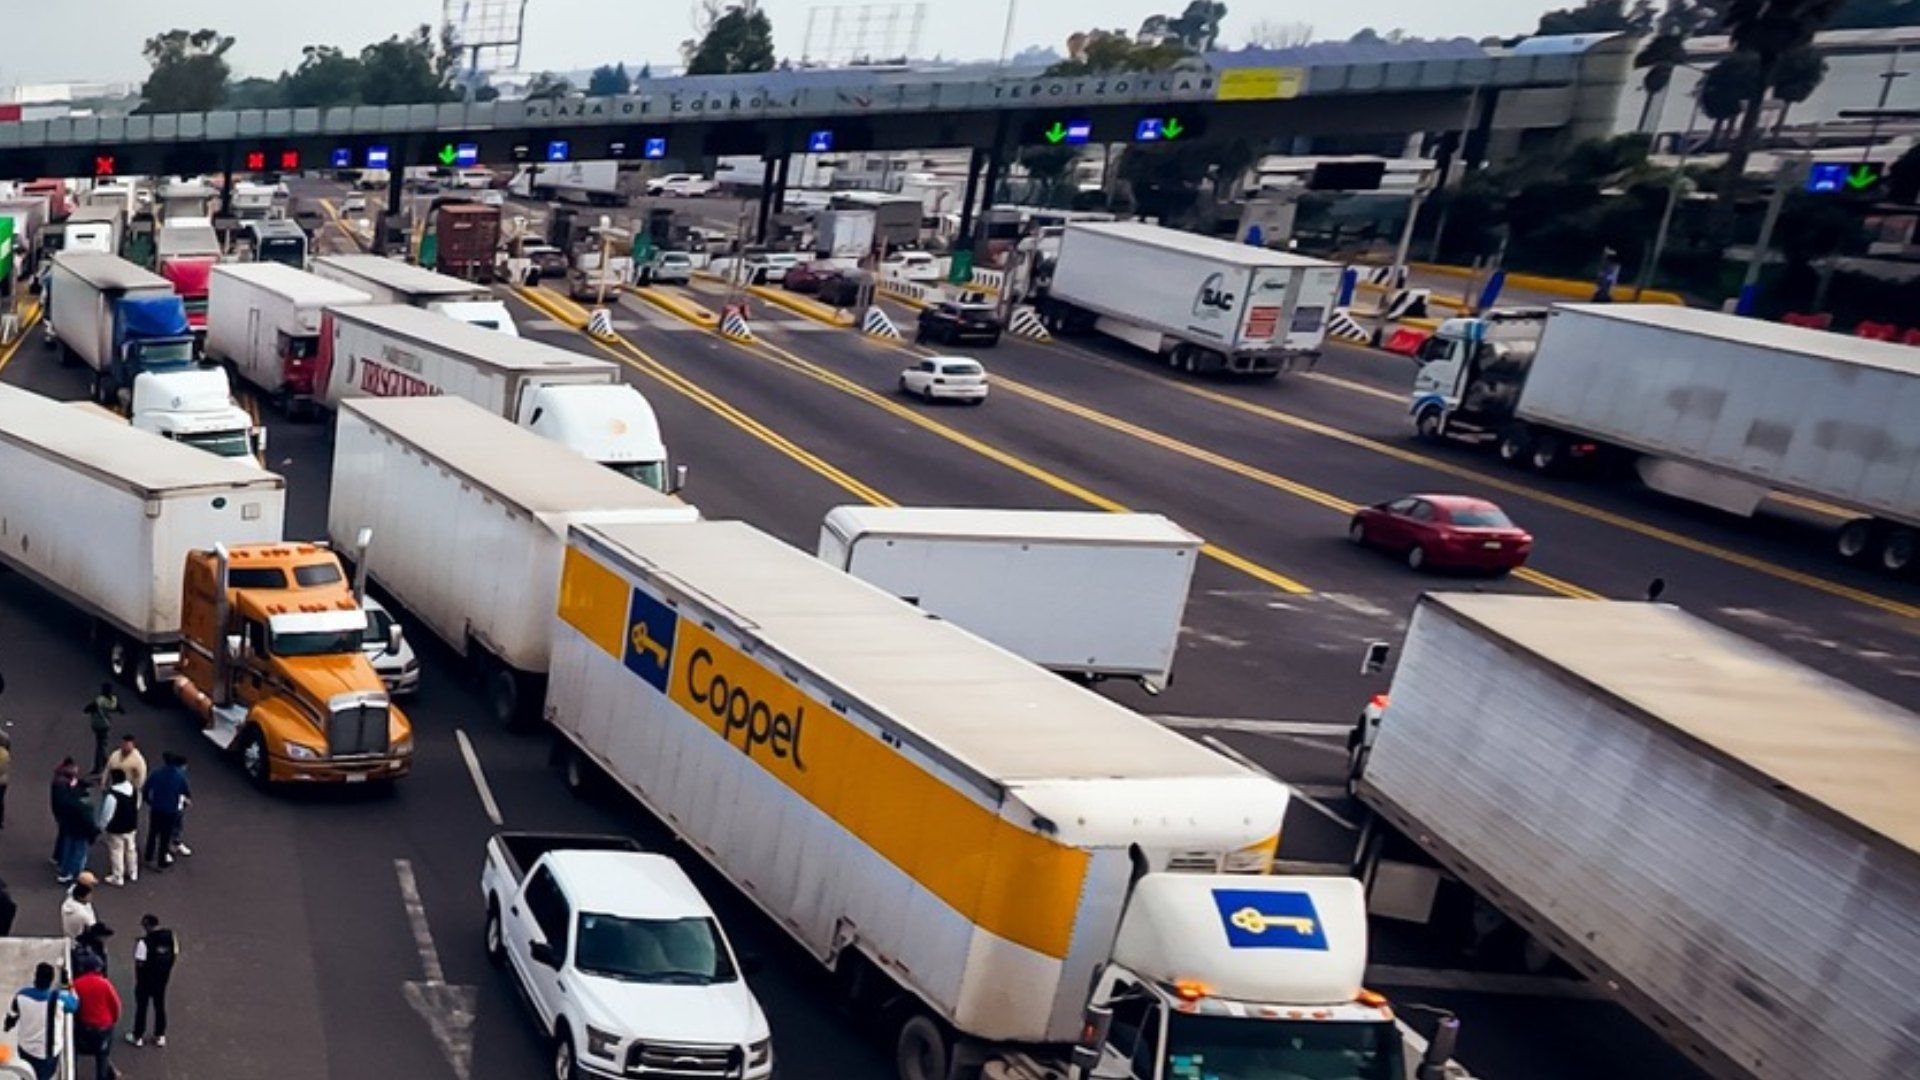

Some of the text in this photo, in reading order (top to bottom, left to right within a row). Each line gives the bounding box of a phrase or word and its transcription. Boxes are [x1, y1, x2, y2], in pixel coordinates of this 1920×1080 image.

[994, 77, 1213, 98] TEPOTZOTLAN
[525, 103, 603, 117] PLAZA
[622, 101, 652, 115] DE
[670, 97, 762, 112] COBRO
[1202, 287, 1235, 311] SAC
[686, 647, 808, 773] Coppel
